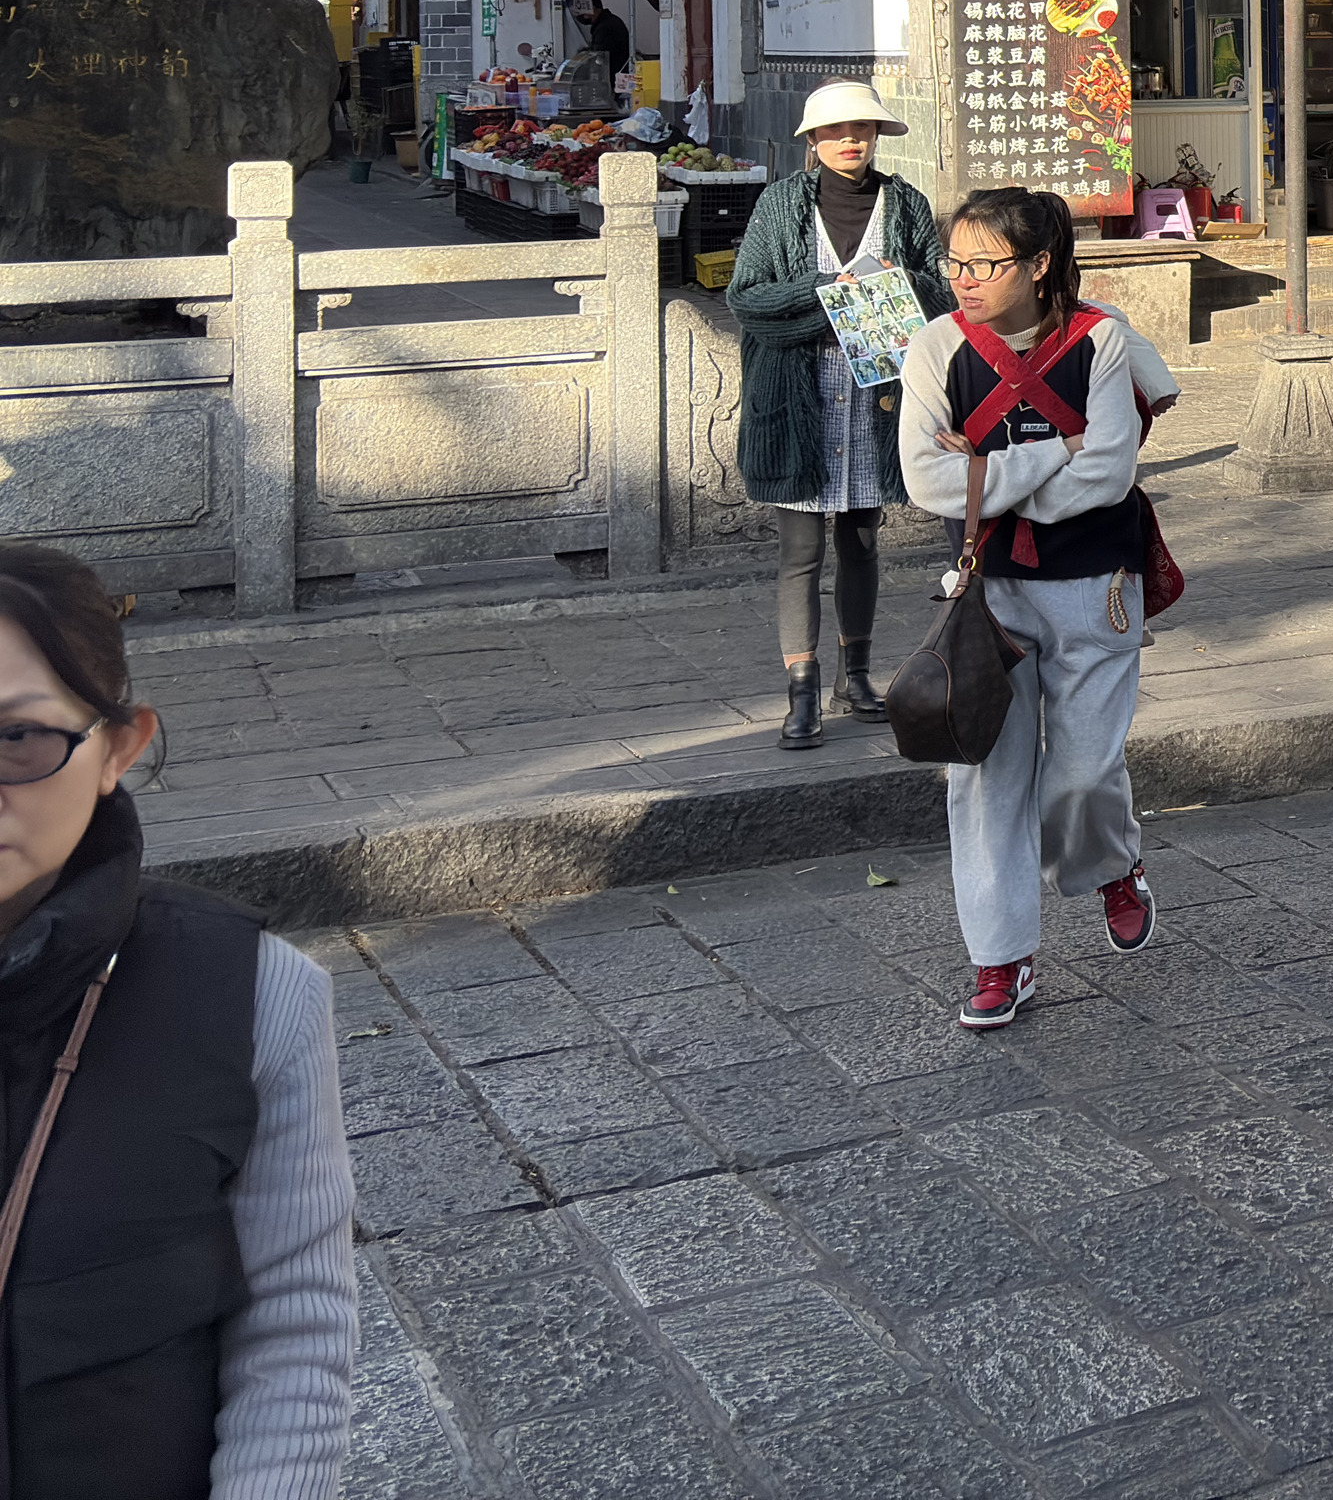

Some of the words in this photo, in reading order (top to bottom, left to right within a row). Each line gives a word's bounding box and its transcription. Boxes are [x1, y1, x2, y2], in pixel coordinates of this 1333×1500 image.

[963, 2, 1046, 20] 锡纸花甲
[963, 24, 1048, 42] 麻辣脑花
[965, 46, 1046, 65] 包浆豆腐
[965, 69, 1046, 88] 建水豆腐
[966, 91, 1068, 111] 锡纸金针菇
[967, 114, 1069, 134] 牛筋小饵块
[967, 136, 1070, 156] 秘制烤五花
[967, 158, 1089, 179] 蒜香肉末茄子
